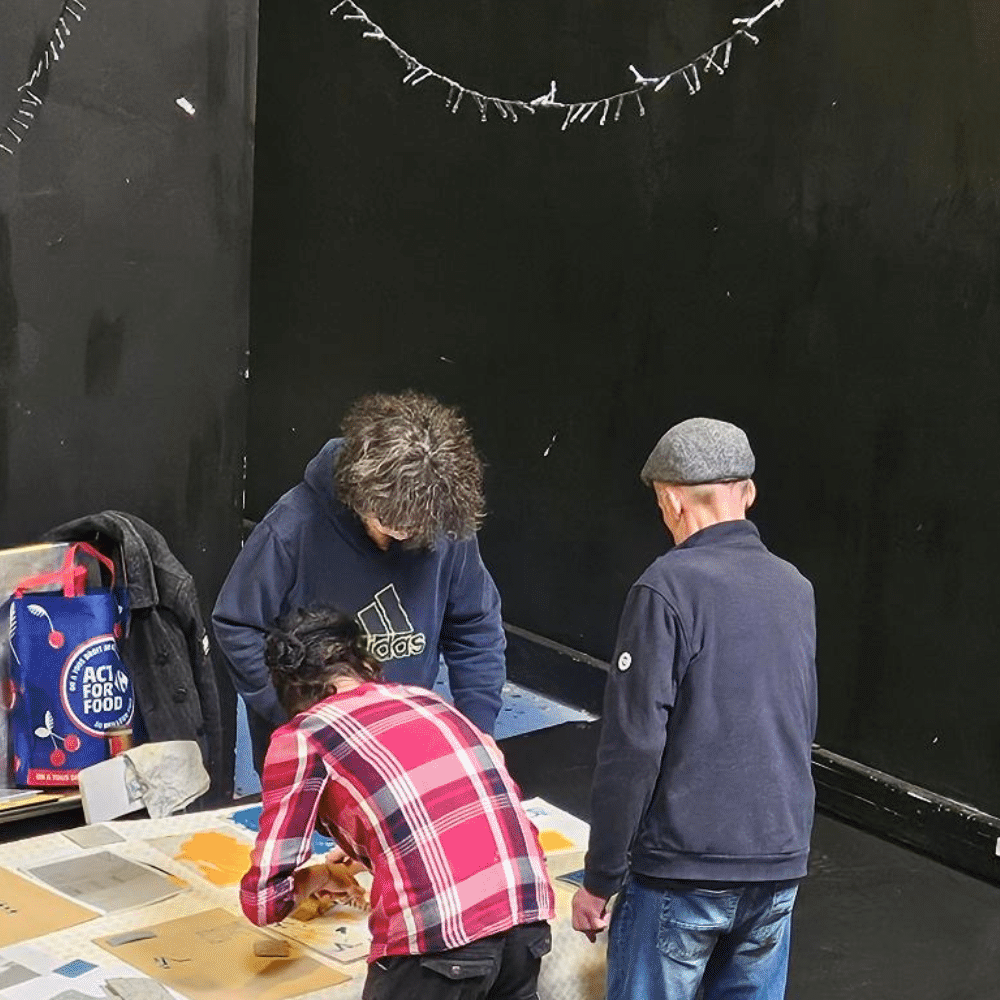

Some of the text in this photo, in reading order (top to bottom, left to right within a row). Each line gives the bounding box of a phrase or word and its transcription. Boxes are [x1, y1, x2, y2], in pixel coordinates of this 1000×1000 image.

[82, 665, 113, 683] ACT
[82, 682, 114, 699] FOR
[83, 697, 123, 714] FOOD
